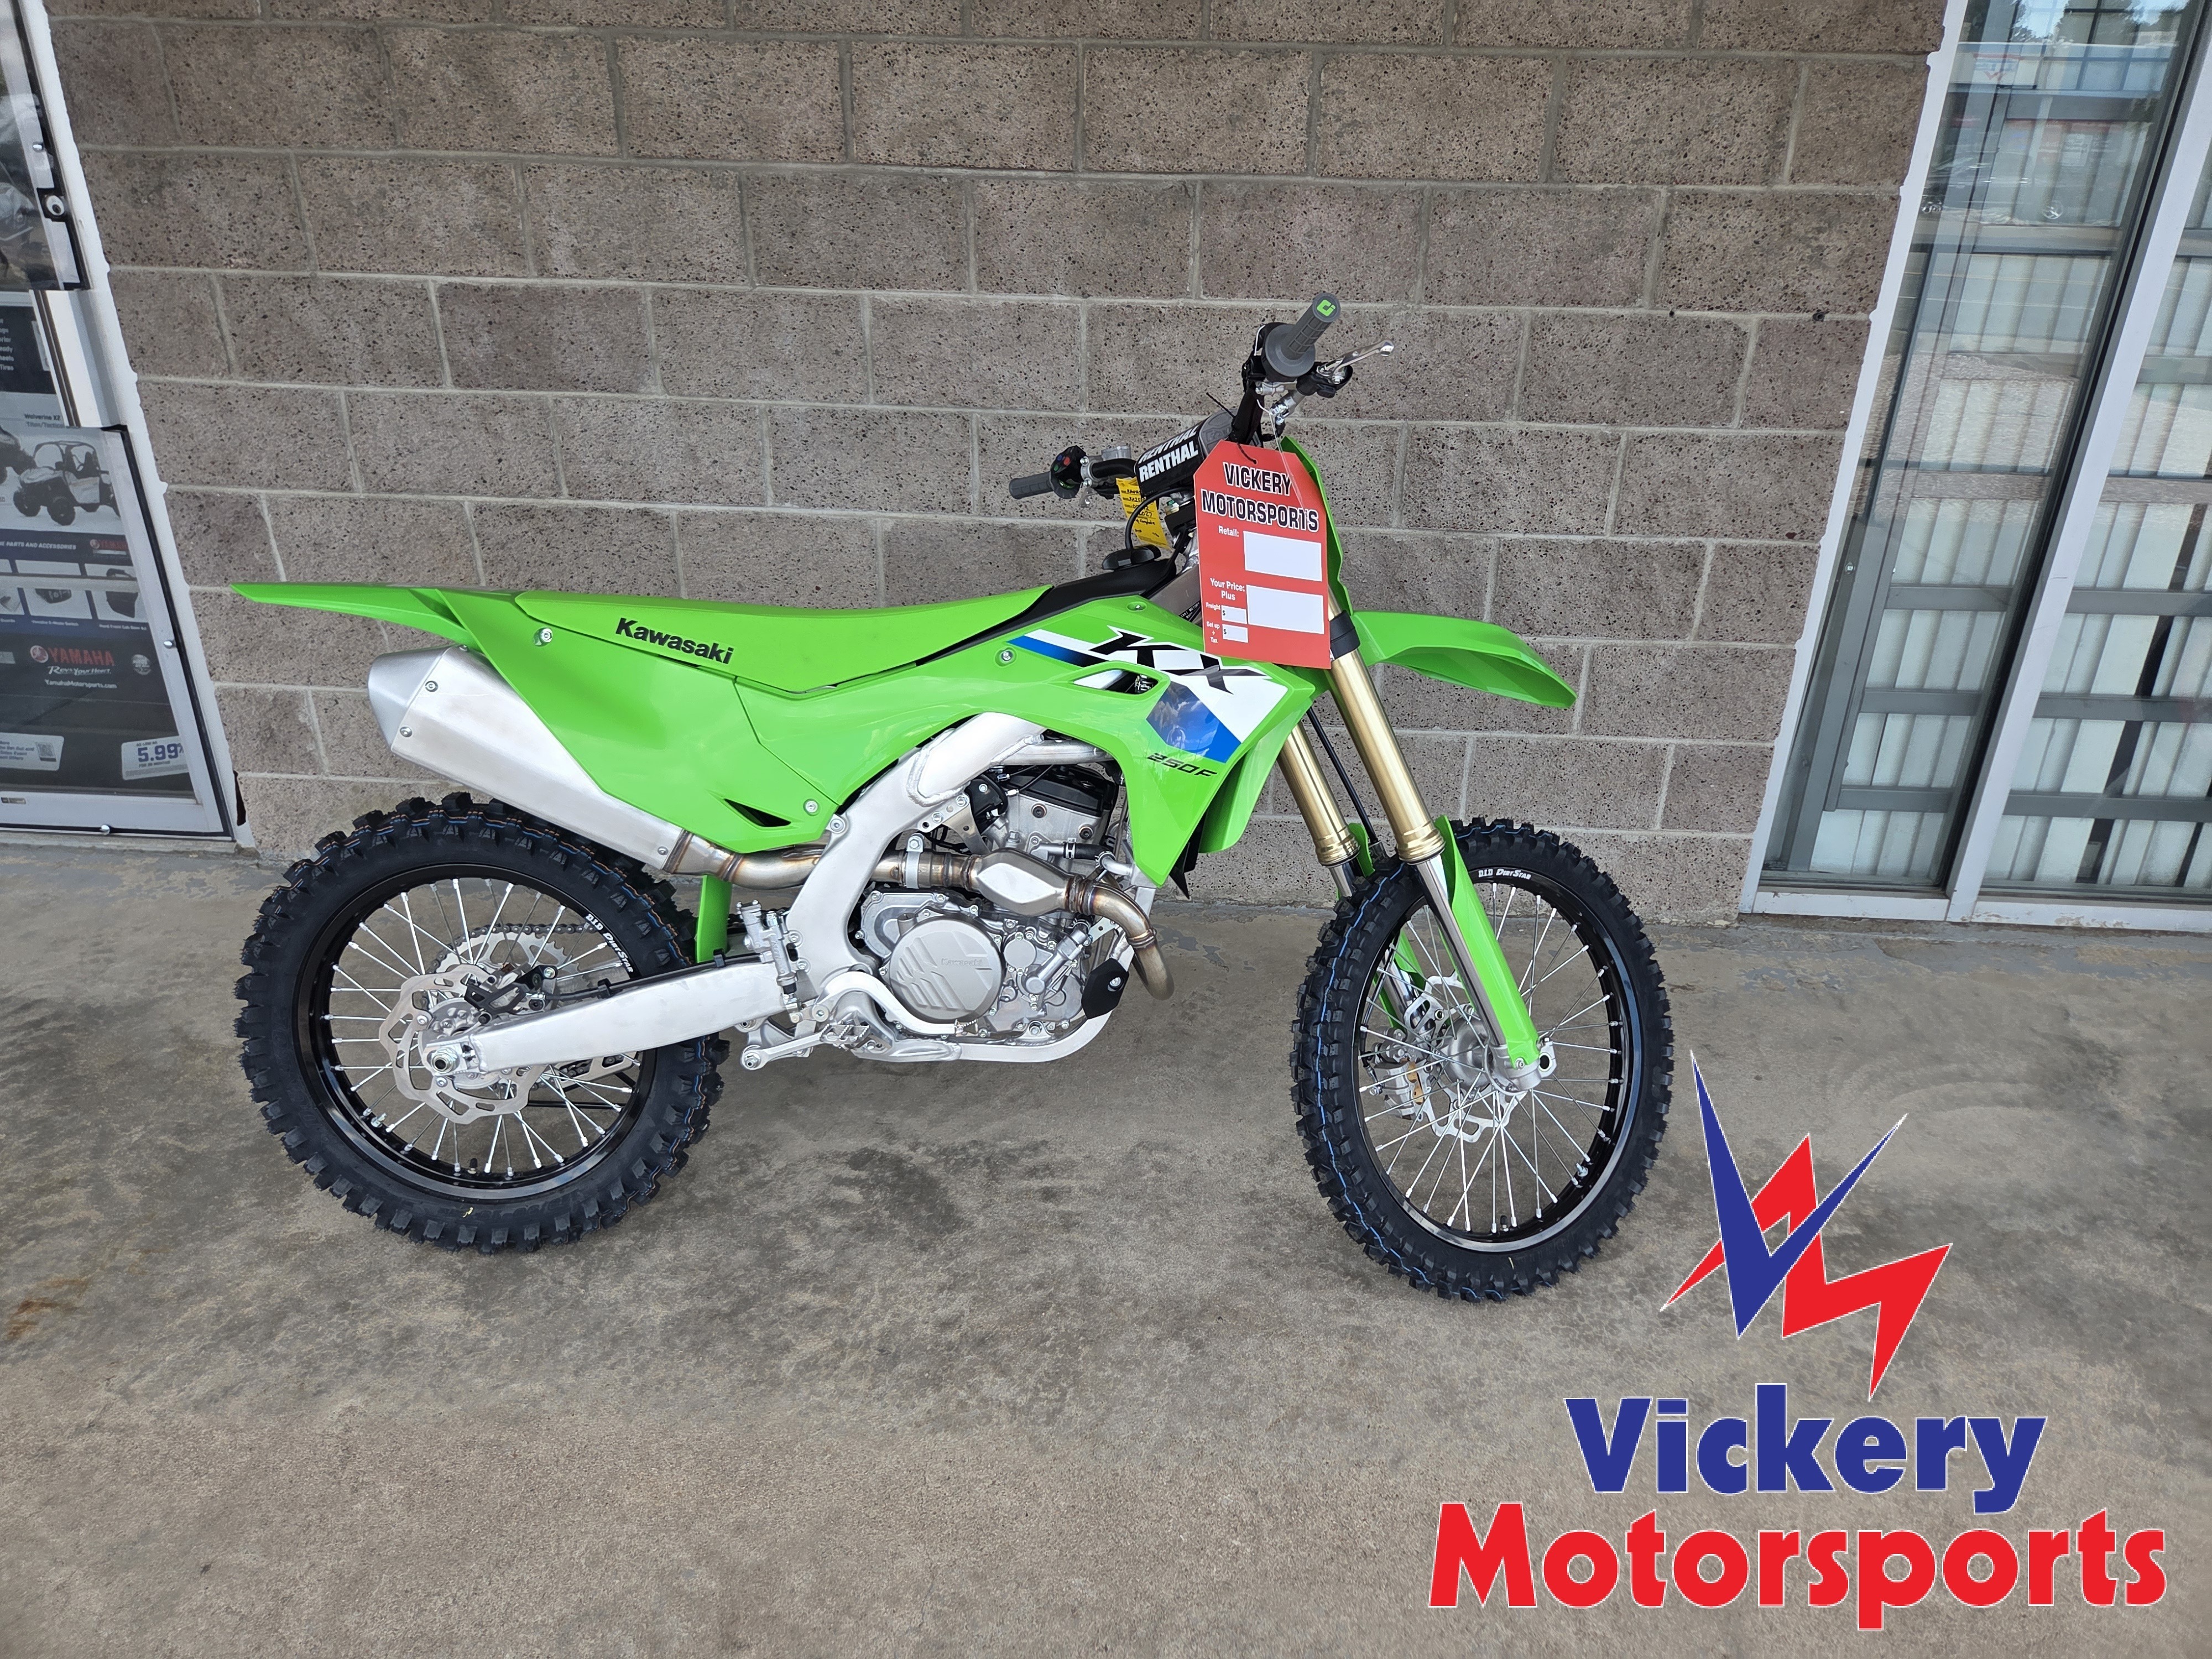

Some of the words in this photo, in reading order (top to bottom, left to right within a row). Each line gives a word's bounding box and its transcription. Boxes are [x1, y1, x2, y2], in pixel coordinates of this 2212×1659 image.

[1139, 441, 1198, 483] RENTHAL
[1223, 461, 1292, 497] VICKERY
[1201, 489, 1319, 533] MOTORSPORTS
[1218, 525, 1239, 538] Retail:
[1210, 577, 1225, 588] Your
[1226, 581, 1245, 592] Price:
[1221, 590, 1235, 601] Plus
[1206, 602, 1220, 611] Freight
[615, 617, 734, 664] Kawasaki
[48, 648, 115, 666] YAMAHA
[1088, 630, 1269, 695] KX
[44, 679, 117, 689] YamahaMotorsports.com
[1146, 753, 1218, 777] 250F
